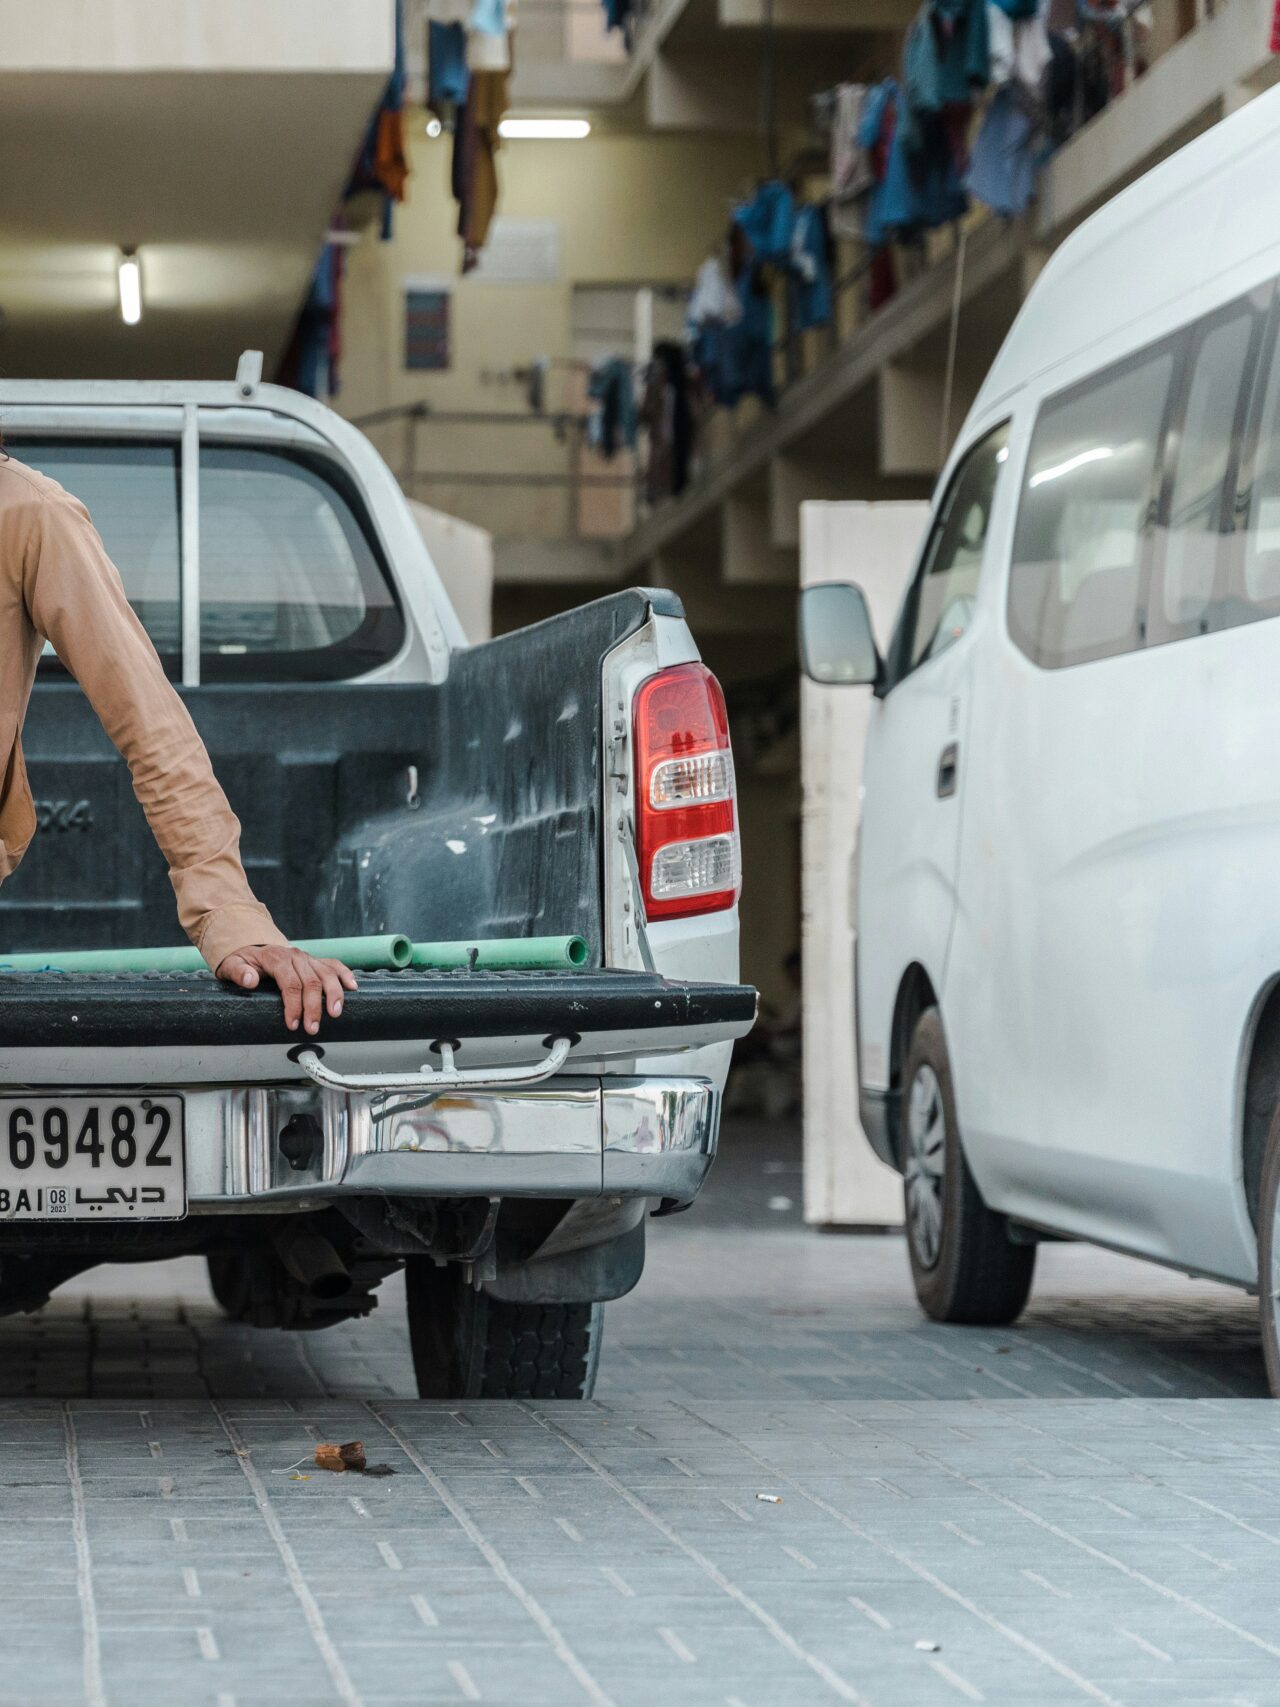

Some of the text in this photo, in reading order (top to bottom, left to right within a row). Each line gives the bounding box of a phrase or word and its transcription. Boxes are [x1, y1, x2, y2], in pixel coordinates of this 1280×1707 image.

[8, 1105, 173, 1170] 69482
[49, 1189, 67, 1205] 08
[75, 1186, 166, 1211] دبي
[49, 1205, 68, 1213] 2023
